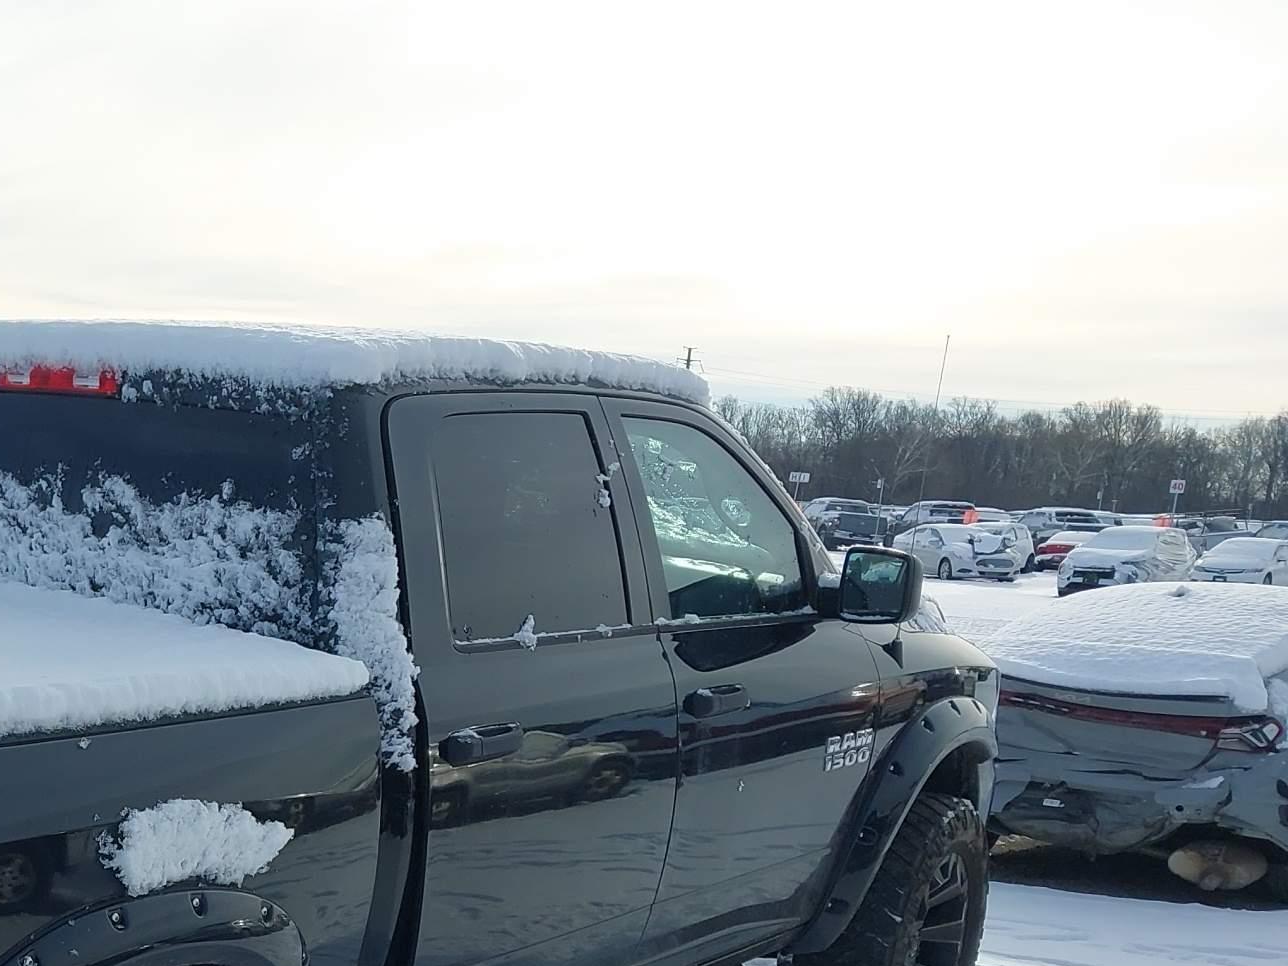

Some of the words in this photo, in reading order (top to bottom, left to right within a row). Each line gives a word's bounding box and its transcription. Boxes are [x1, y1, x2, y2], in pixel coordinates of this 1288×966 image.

[1171, 482, 1184, 491] 40
[826, 728, 874, 754] RAM
[824, 746, 870, 771] 1500
